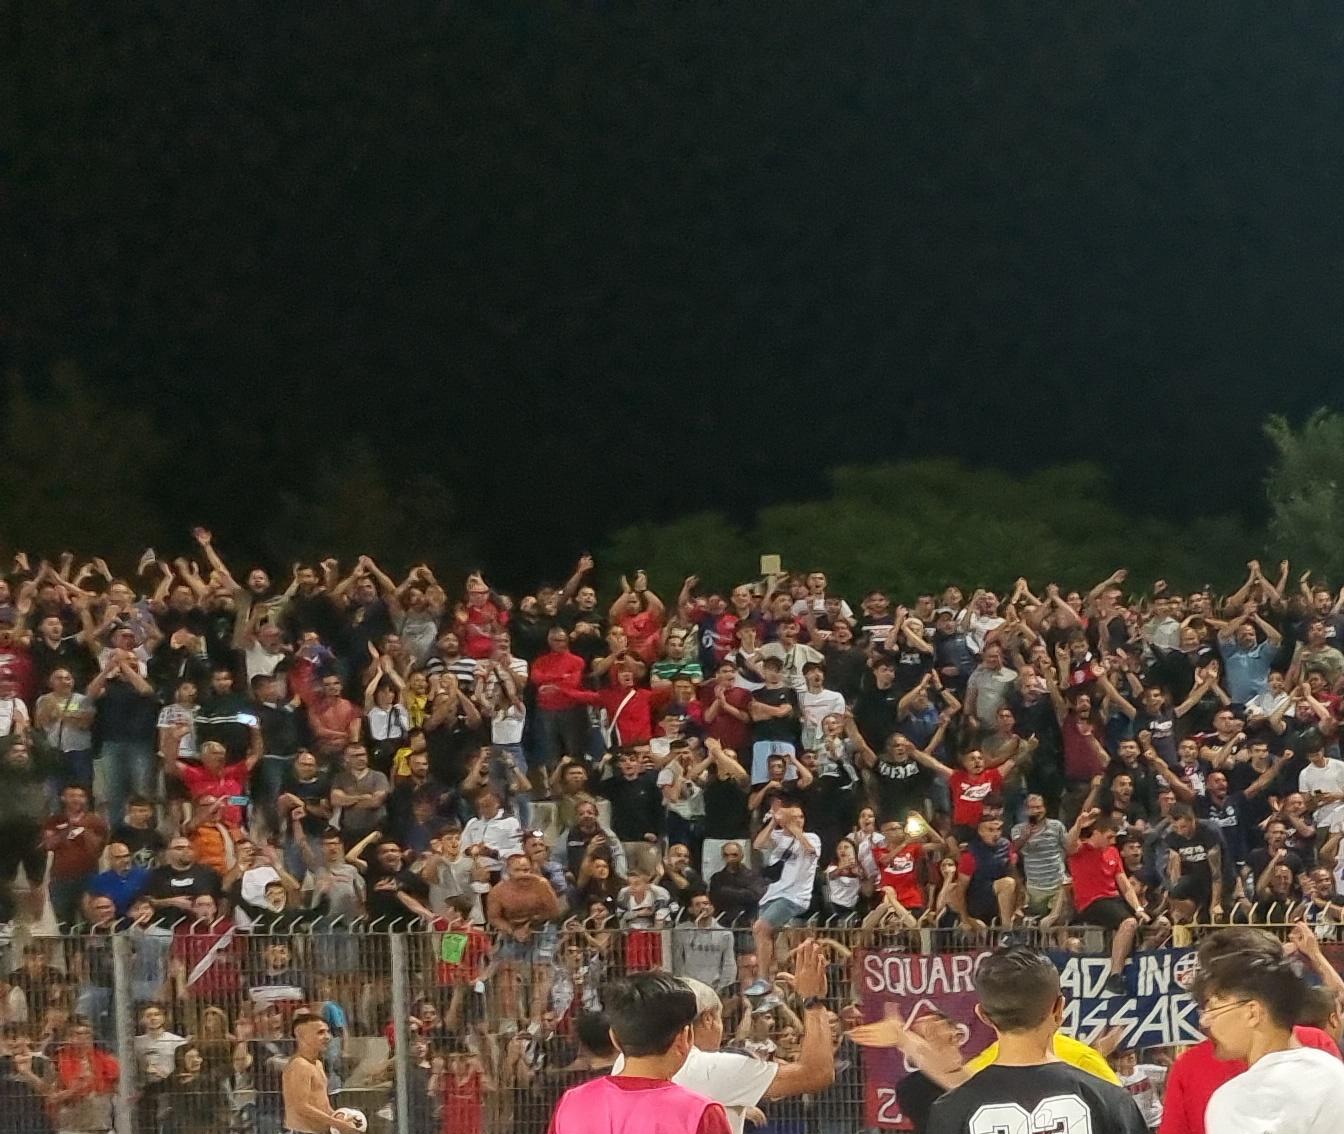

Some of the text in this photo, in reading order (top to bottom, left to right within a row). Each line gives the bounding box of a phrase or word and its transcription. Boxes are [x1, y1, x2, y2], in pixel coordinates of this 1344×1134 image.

[1059, 954, 1171, 999] AD IN
[1060, 992, 1208, 1048] ASSAR
